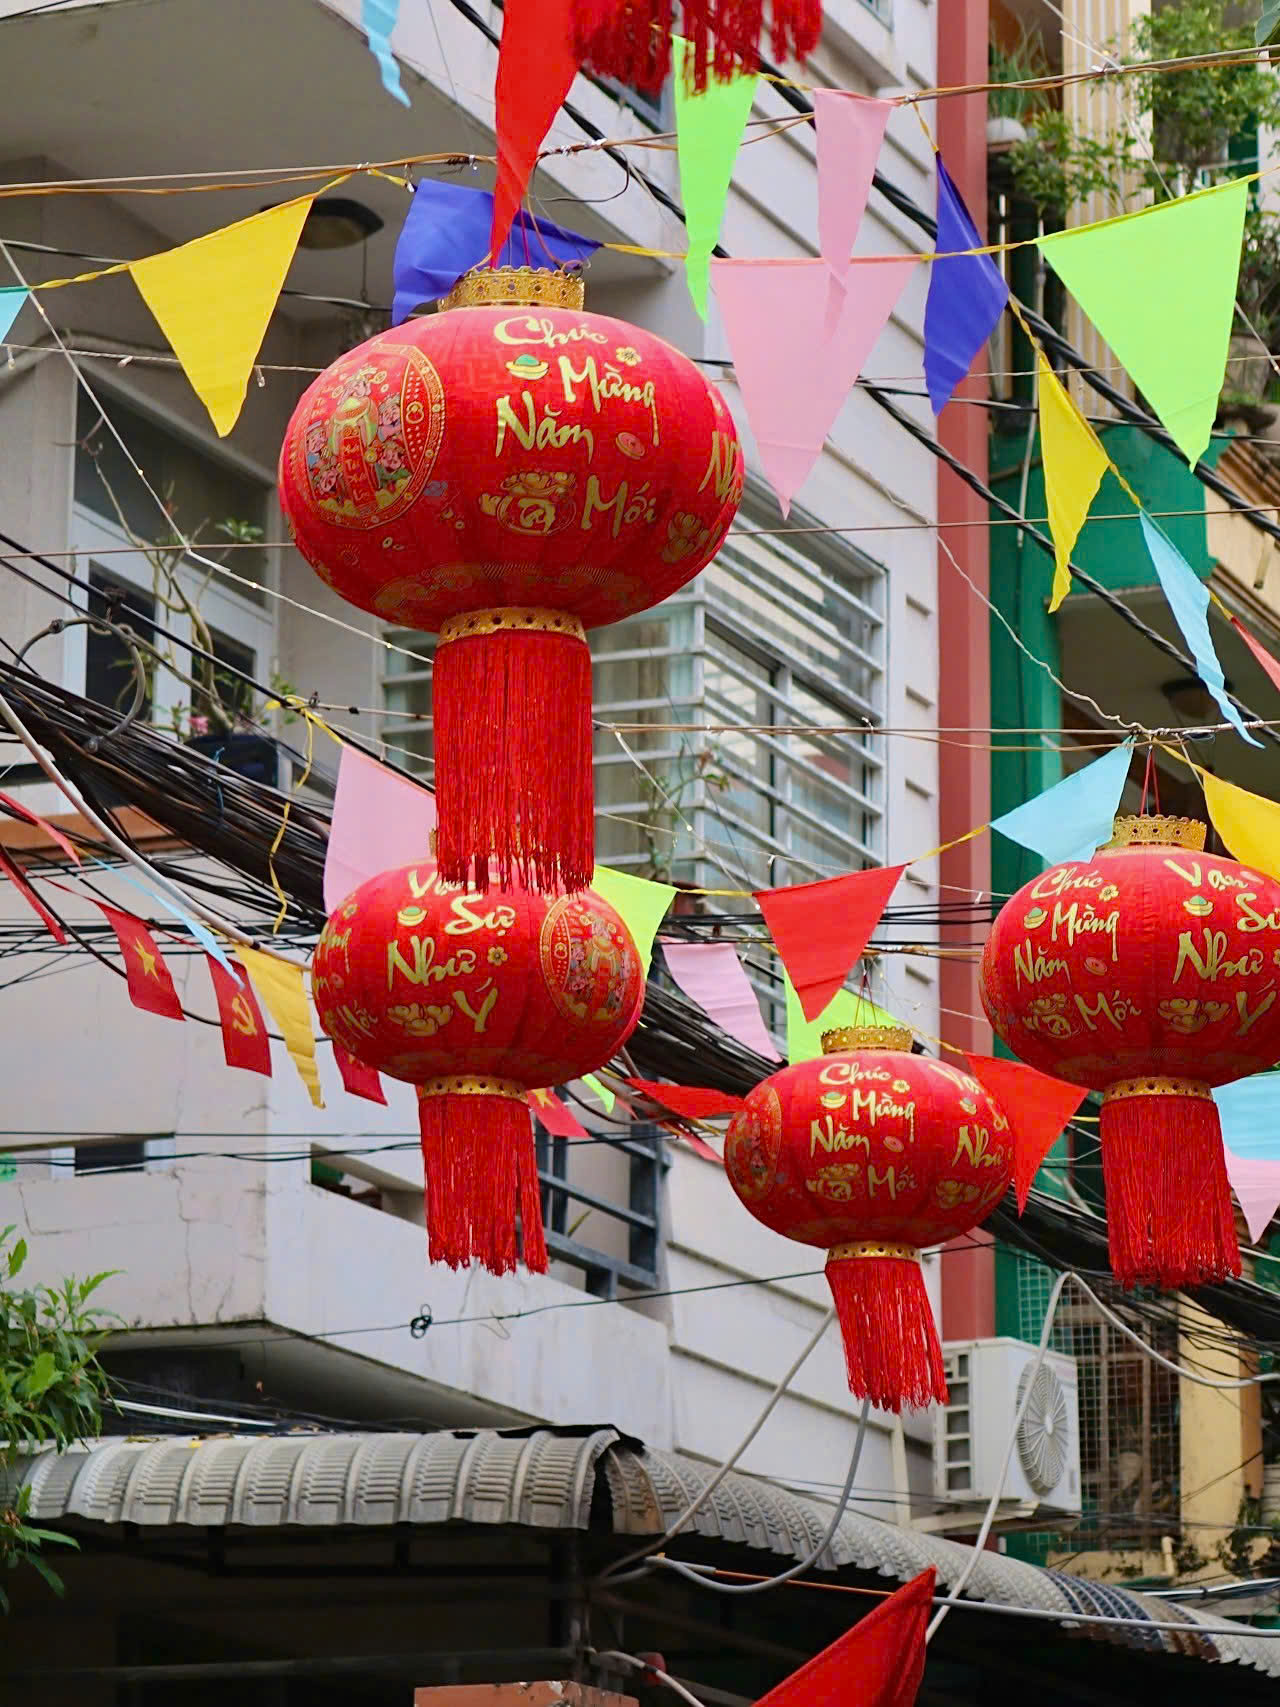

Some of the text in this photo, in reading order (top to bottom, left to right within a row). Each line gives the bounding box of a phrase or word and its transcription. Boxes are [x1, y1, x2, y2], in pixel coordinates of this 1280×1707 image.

[494, 316, 608, 348] Chúc
[495, 391, 594, 464] Năm
[558, 355, 660, 447] Mừng
[581, 474, 657, 538] Mới
[1031, 866, 1103, 899] Chúc
[1163, 859, 1249, 891] Vạn
[445, 894, 516, 936] Sự
[1052, 901, 1120, 962] Mừng
[388, 936, 477, 990] Như
[1013, 939, 1071, 992] Năm
[1172, 927, 1265, 985] Như
[453, 977, 498, 1033] Ý
[1073, 990, 1143, 1032] Mới
[1236, 979, 1277, 1037] Ý
[819, 1062, 891, 1085] Chúc
[810, 1115, 870, 1161] Năm
[852, 1088, 916, 1143] Mừng
[867, 1163, 919, 1200] Mới
